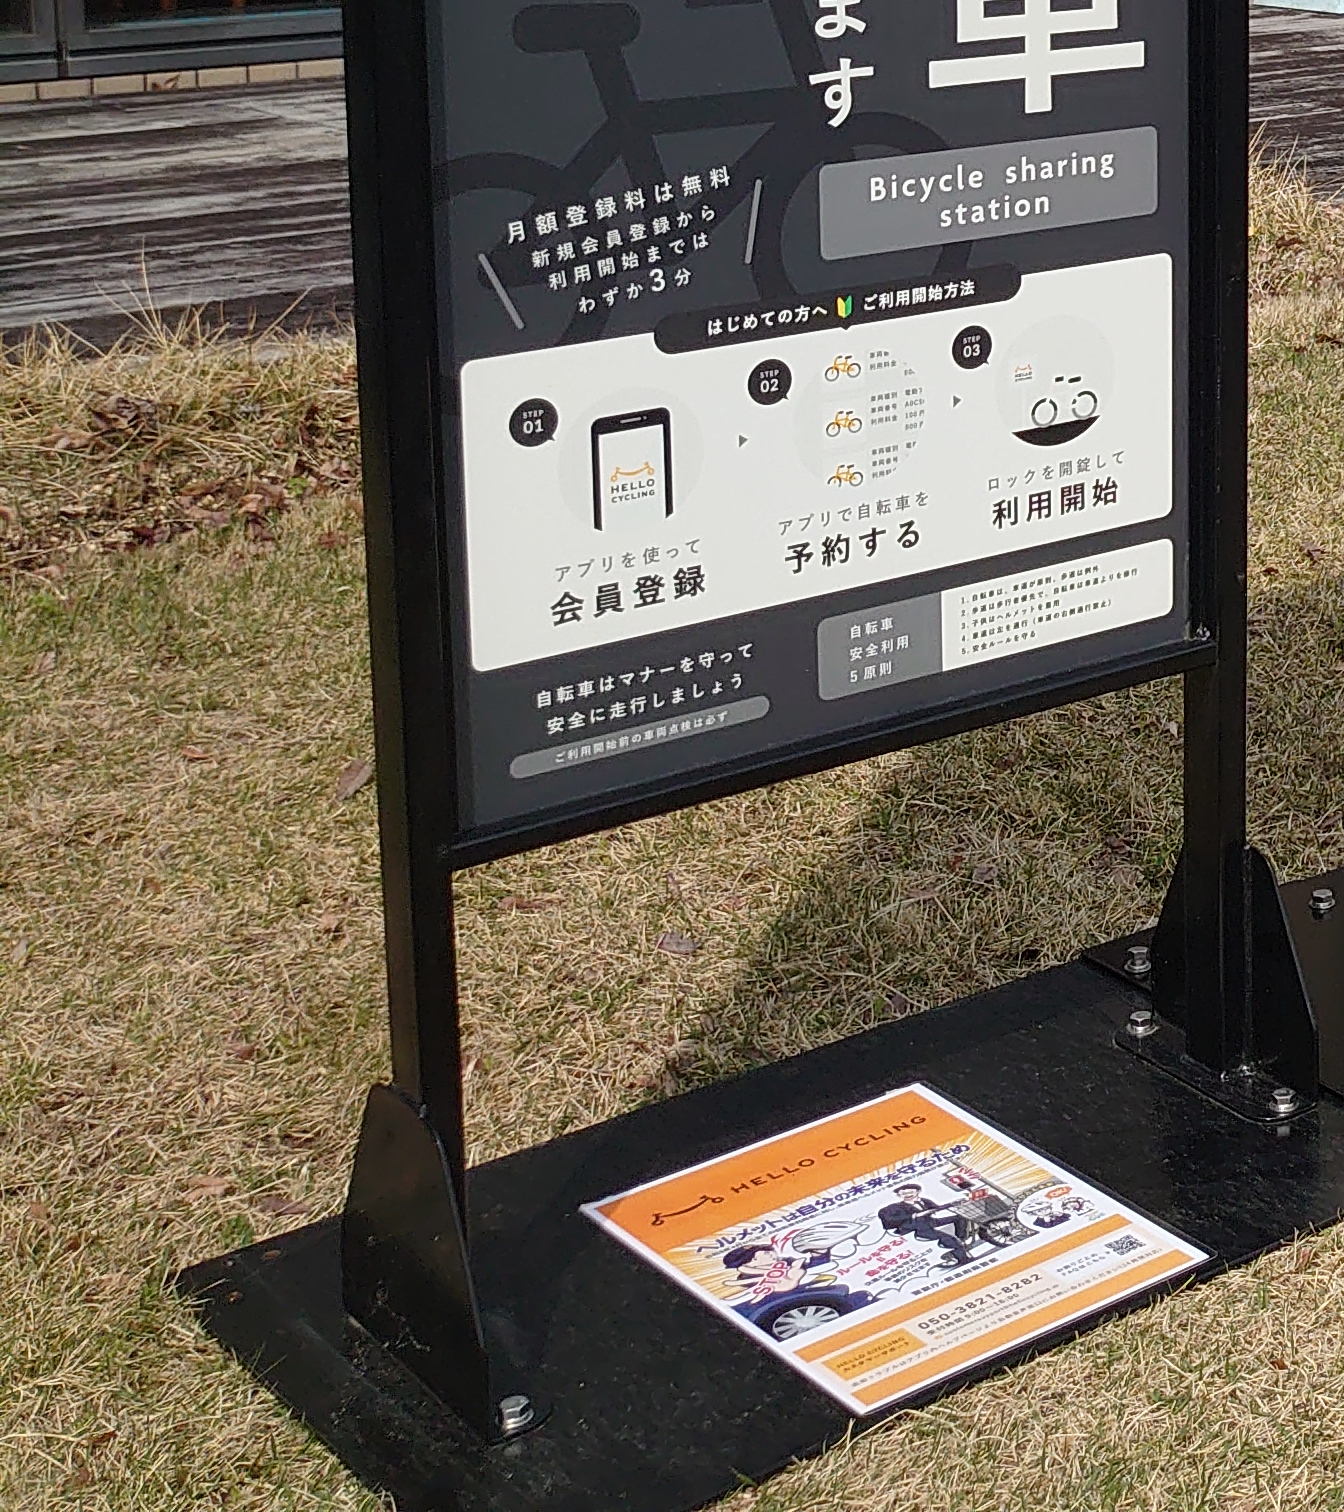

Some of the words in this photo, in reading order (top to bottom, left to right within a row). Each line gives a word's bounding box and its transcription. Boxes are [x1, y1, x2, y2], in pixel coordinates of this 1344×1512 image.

[869, 163, 984, 203] Bicycle
[1005, 151, 1115, 179] sharing
[507, 165, 731, 245] 月額登録料は無料
[940, 194, 1050, 228] station
[532, 204, 716, 269] 新規会員登録から
[548, 231, 709, 290] 利用開始までは
[578, 267, 693, 314] わずか3分
[707, 303, 828, 337] はじめての方へ
[862, 278, 976, 312] ご利用開始方法
[962, 334, 981, 345] STEP
[962, 343, 981, 358] 03
[758, 369, 780, 379] STEP
[759, 378, 780, 394] 02
[522, 409, 545, 420] STEP
[522, 419, 545, 436] 01
[610, 478, 656, 494] HELLO
[988, 450, 1125, 492] ロックを開錠して
[611, 491, 656, 504] CYCLING
[777, 491, 930, 536] アプリで自転車を
[991, 476, 1119, 530] 利用開始
[555, 538, 701, 583] アプリを使って
[784, 519, 922, 575] 予約する
[550, 564, 707, 628] 会員登録
[849, 616, 894, 640] 自転車
[849, 634, 910, 662] 安全利用
[536, 641, 755, 710] 自転車はマナーを守って
[546, 672, 744, 737] 安全に走行しましょう
[730, 1157, 816, 1194] HELLO
[823, 1114, 928, 1162] CYCLING
[752, 1260, 789, 1297] STOP
[917, 1273, 1043, 1331] 050-3821-8282
